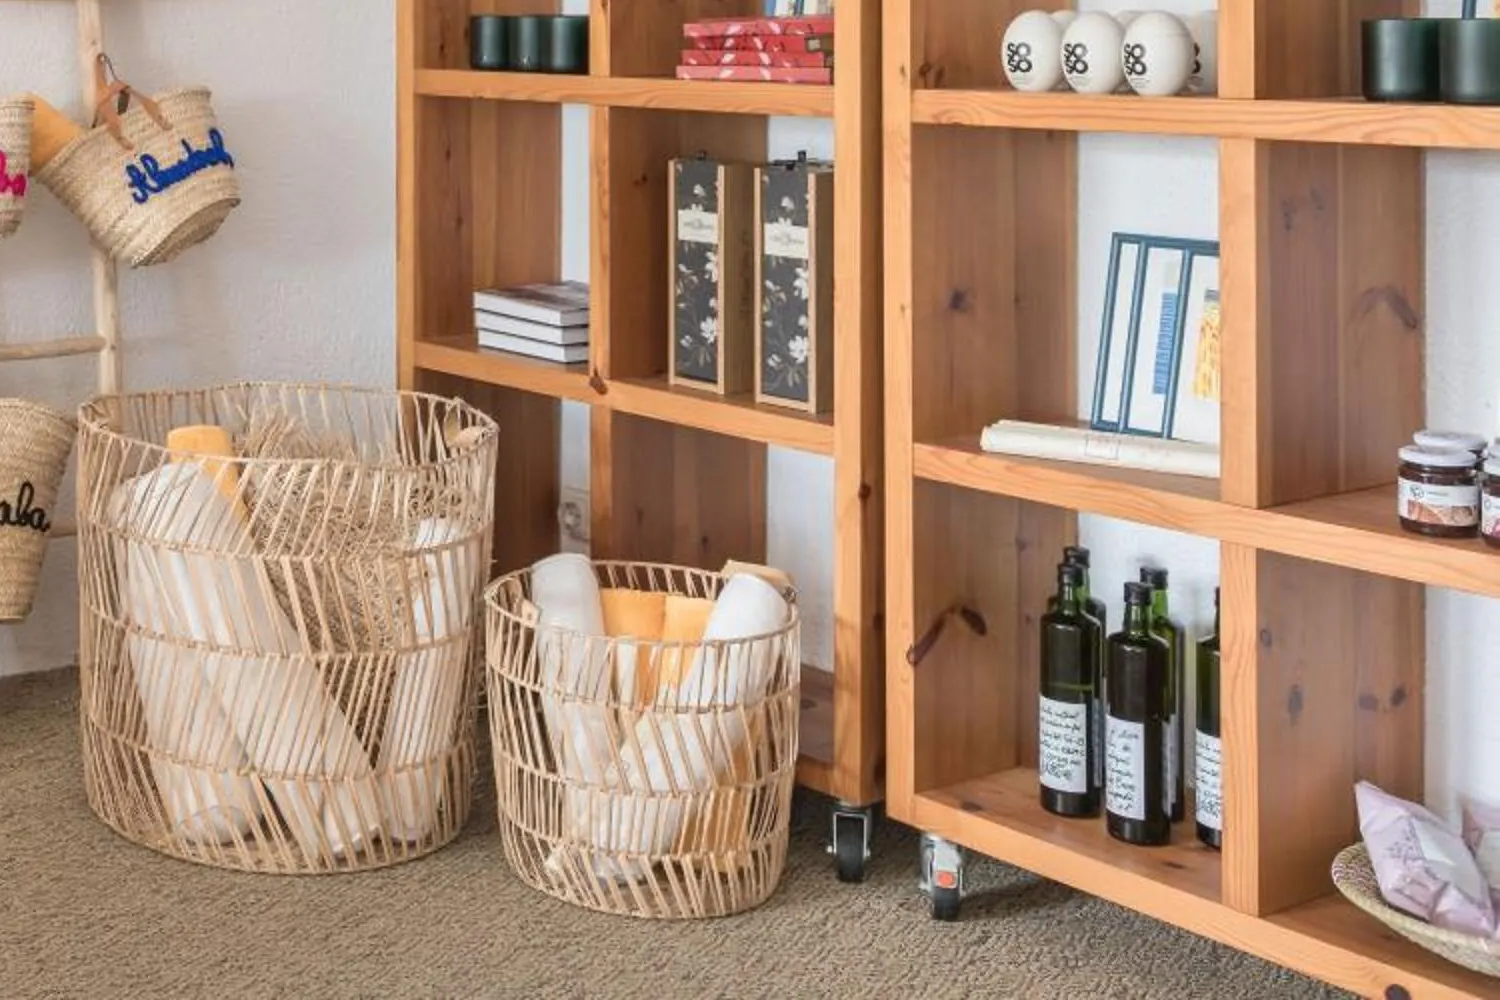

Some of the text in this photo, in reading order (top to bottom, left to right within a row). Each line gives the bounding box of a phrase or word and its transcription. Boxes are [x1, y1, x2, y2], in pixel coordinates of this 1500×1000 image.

[1007, 42, 1031, 58] SO
[1063, 42, 1088, 59] SO
[1123, 43, 1146, 60] SO
[1007, 57, 1033, 73] SO
[1064, 58, 1089, 74] SO
[1125, 59, 1147, 75] SO
